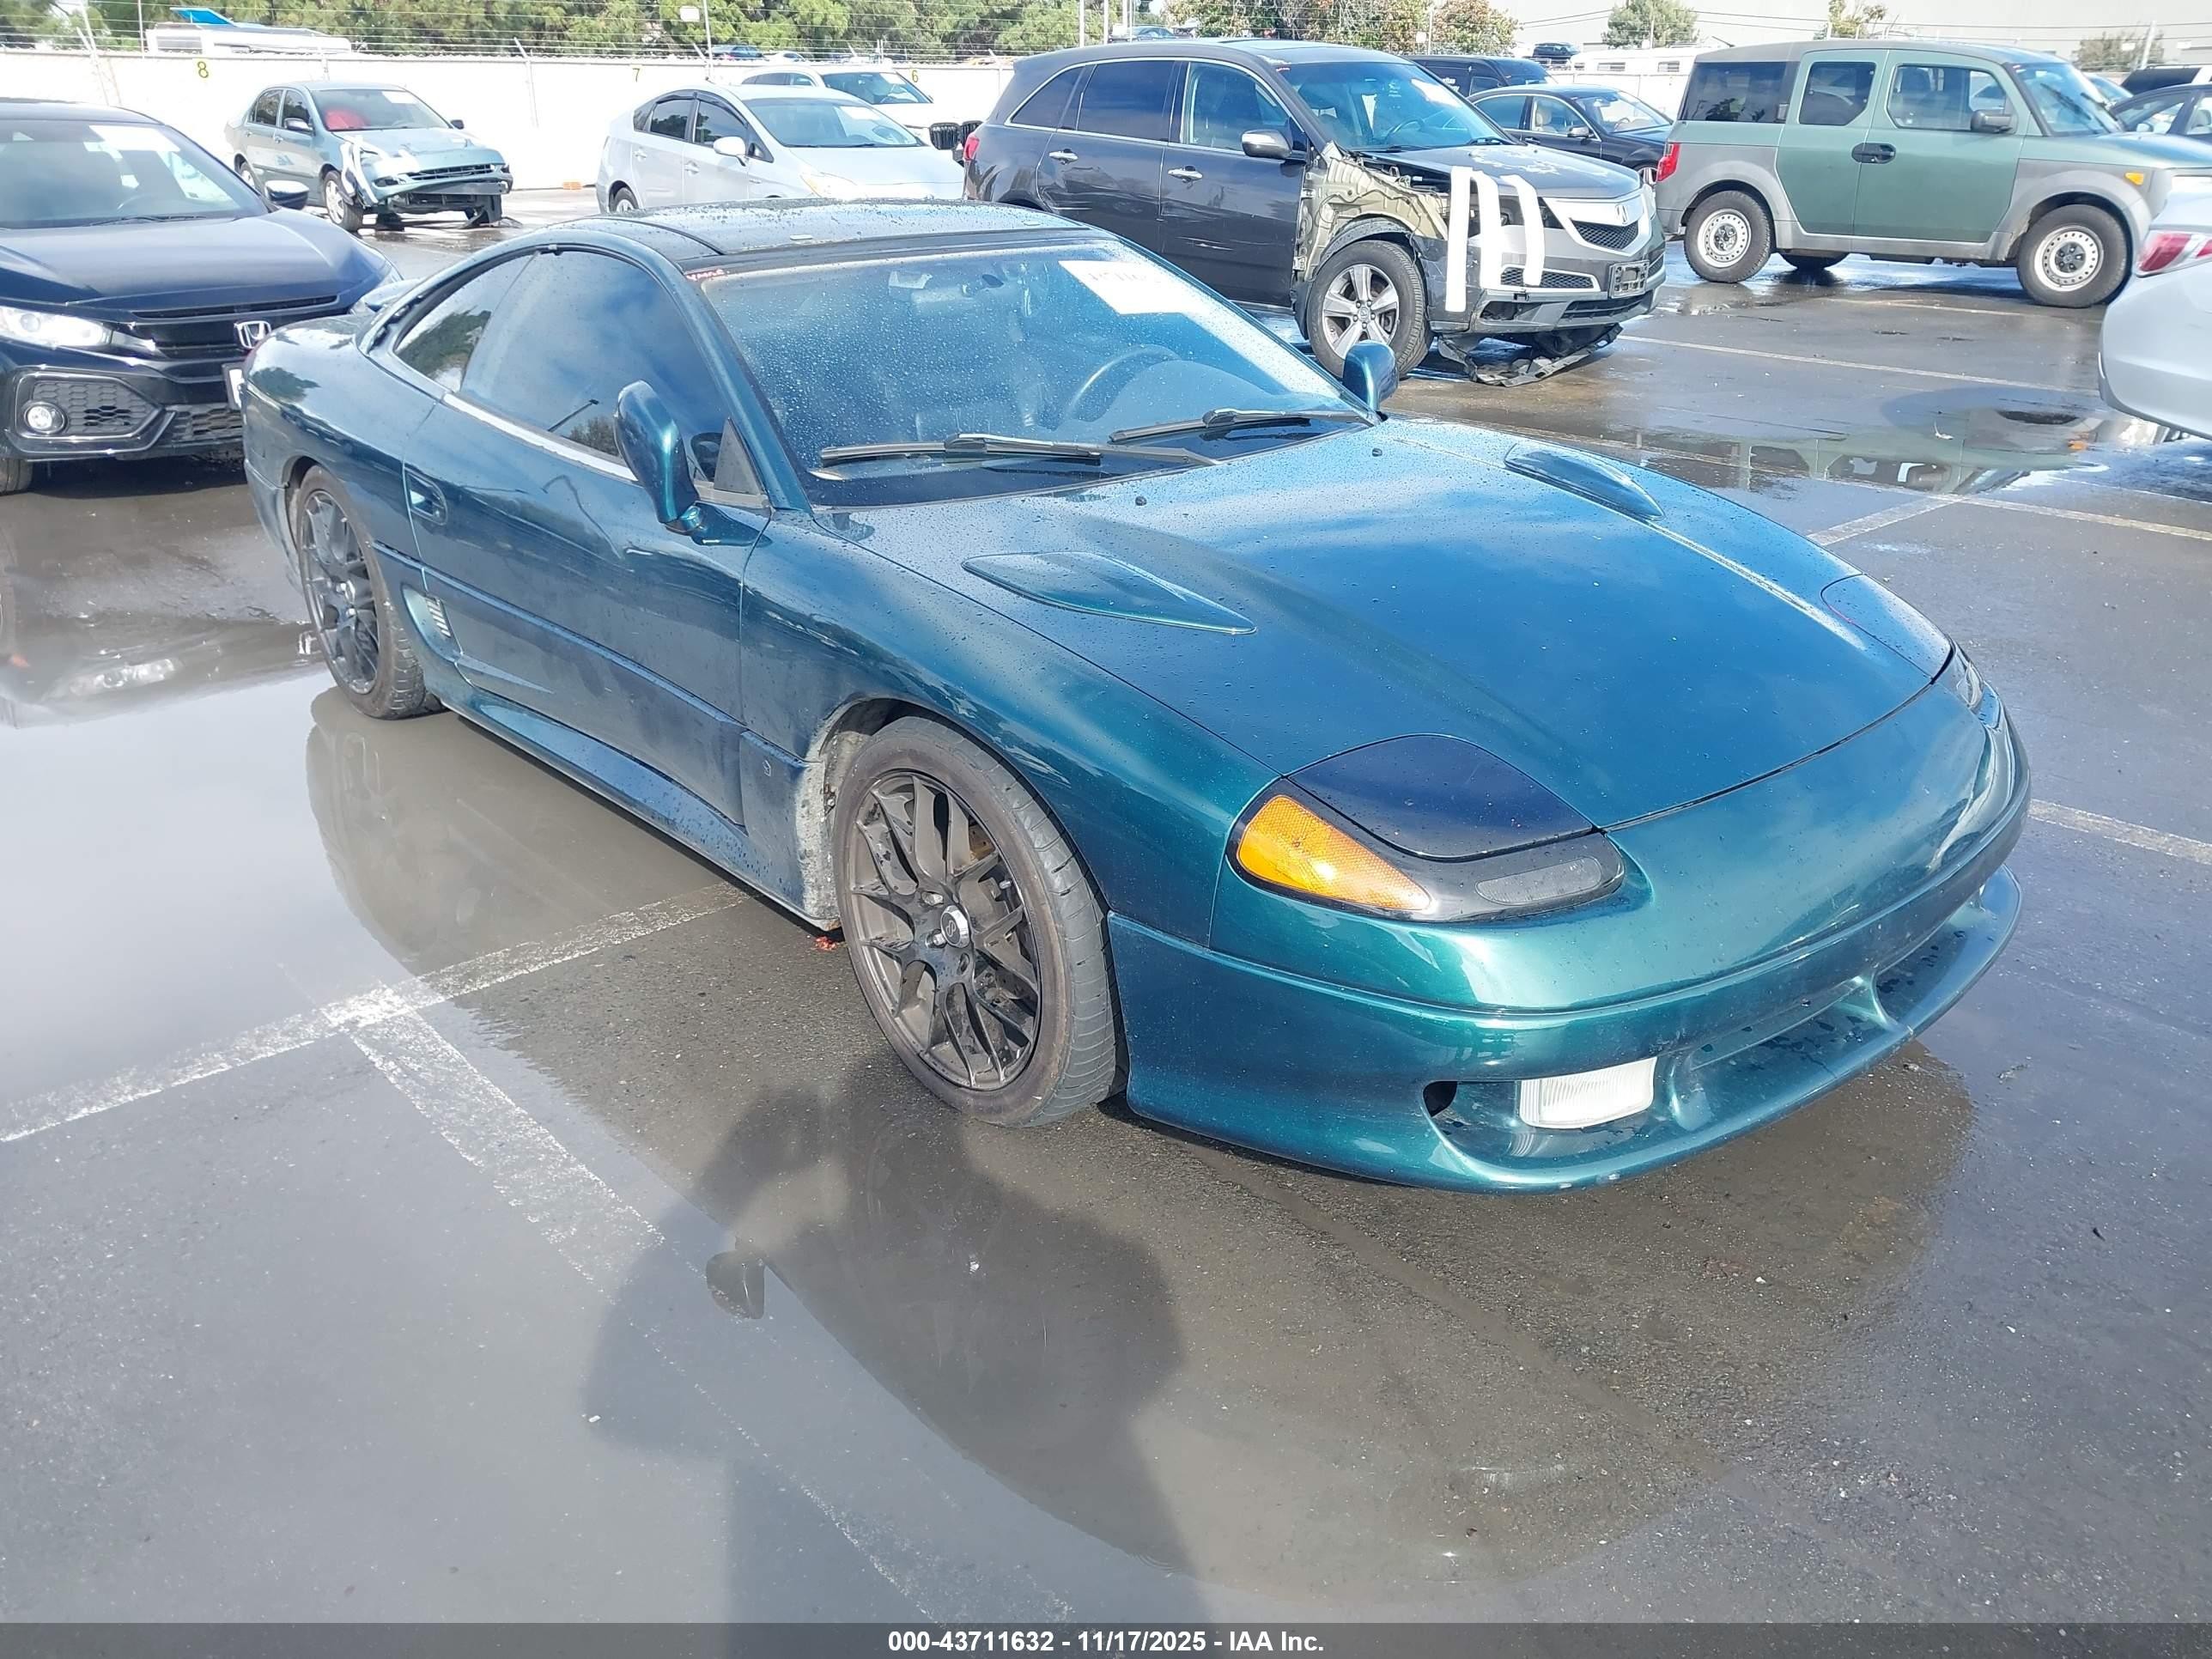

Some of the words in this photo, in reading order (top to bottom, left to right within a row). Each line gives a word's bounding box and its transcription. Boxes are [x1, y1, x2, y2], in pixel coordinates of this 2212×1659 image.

[198, 61, 209, 78] 8
[632, 68, 641, 82] 7
[911, 70, 919, 83] 6
